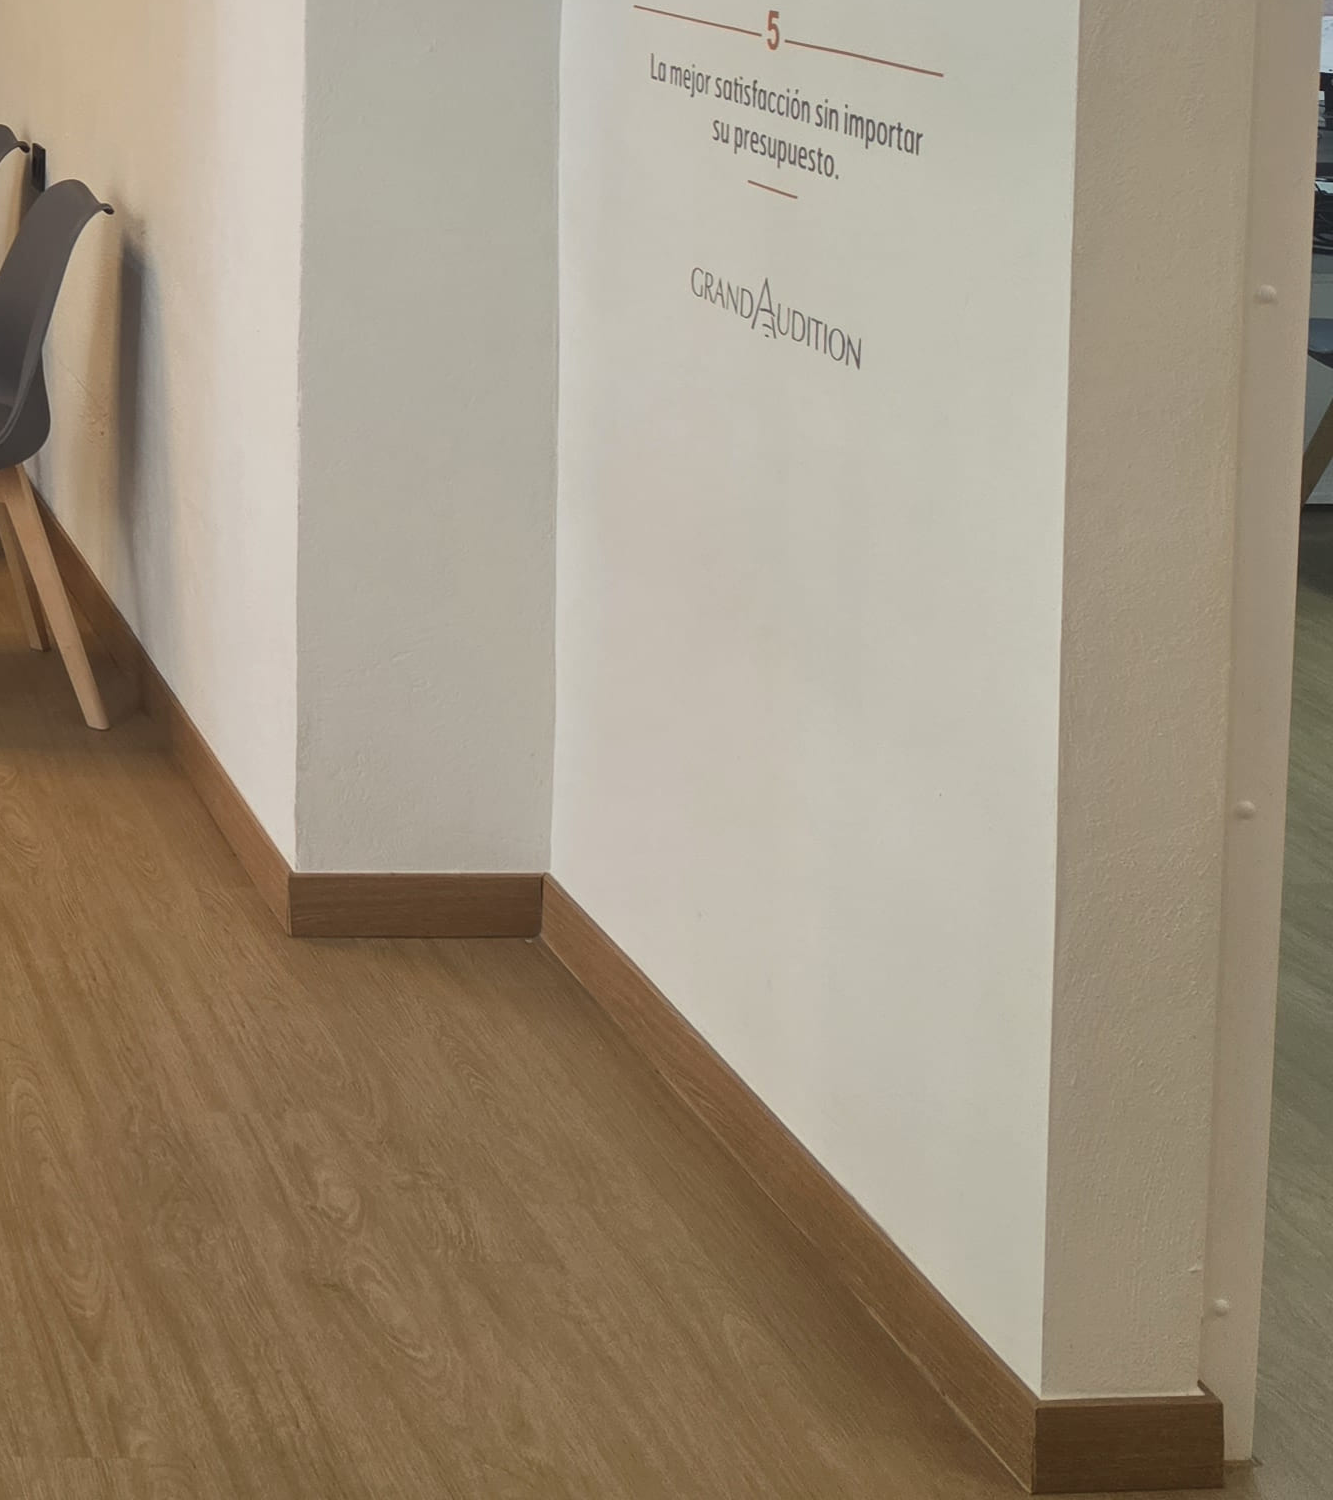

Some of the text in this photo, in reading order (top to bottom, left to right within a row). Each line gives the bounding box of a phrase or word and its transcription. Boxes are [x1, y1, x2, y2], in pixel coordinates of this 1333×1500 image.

[766, 10, 780, 51] 5
[651, 53, 923, 156] La mejor satisfacción sin importar
[712, 120, 839, 180] su presupuesto.
[690, 266, 863, 370] GRANDAUDITION
